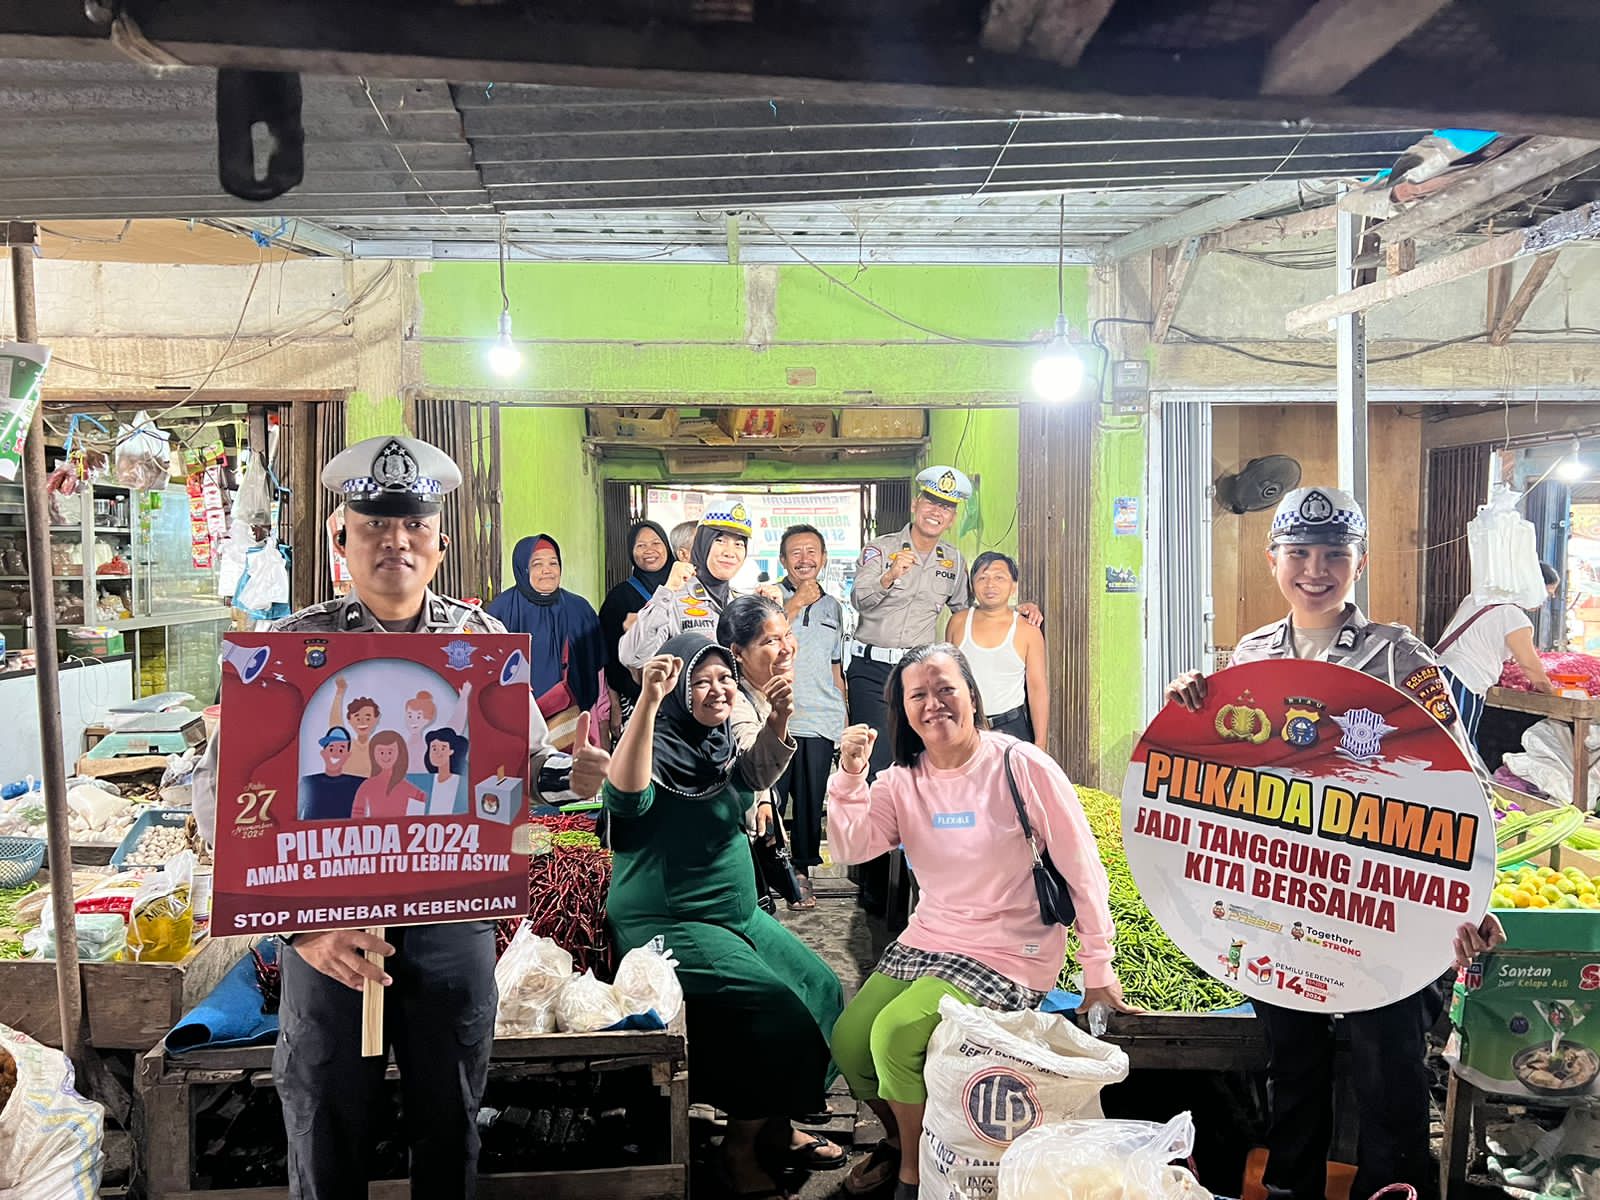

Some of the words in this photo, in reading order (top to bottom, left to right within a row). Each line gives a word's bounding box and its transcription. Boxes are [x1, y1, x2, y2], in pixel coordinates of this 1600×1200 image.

[235, 789, 278, 824] 27
[1144, 752, 1312, 832] PILKADA
[1320, 788, 1477, 868] DAMAI
[276, 825, 401, 863] PILKADA
[407, 823, 480, 855] 2024
[246, 864, 299, 887] AMAN
[302, 863, 316, 880] &
[320, 857, 377, 879] DAMAI
[380, 855, 408, 874] ITU
[412, 855, 459, 872] LEBIH
[460, 855, 510, 872] ASYIK
[1134, 807, 1191, 845] JADI
[1197, 821, 1350, 885] TANGGUNG
[1357, 859, 1471, 913] JAWAB
[1184, 851, 1245, 892] KITA
[1251, 869, 1397, 932] BERSAMA
[233, 911, 291, 929] STOP
[296, 905, 397, 925] MENEBAR
[403, 895, 517, 917] KEBENCIAN
[1306, 926, 1354, 946] Together
[1321, 940, 1362, 957] STRONG
[1275, 962, 1304, 976] PEMILU
[1305, 971, 1345, 988] SERENTAK
[1275, 970, 1304, 995] 14
[1498, 964, 1552, 977] Santan
